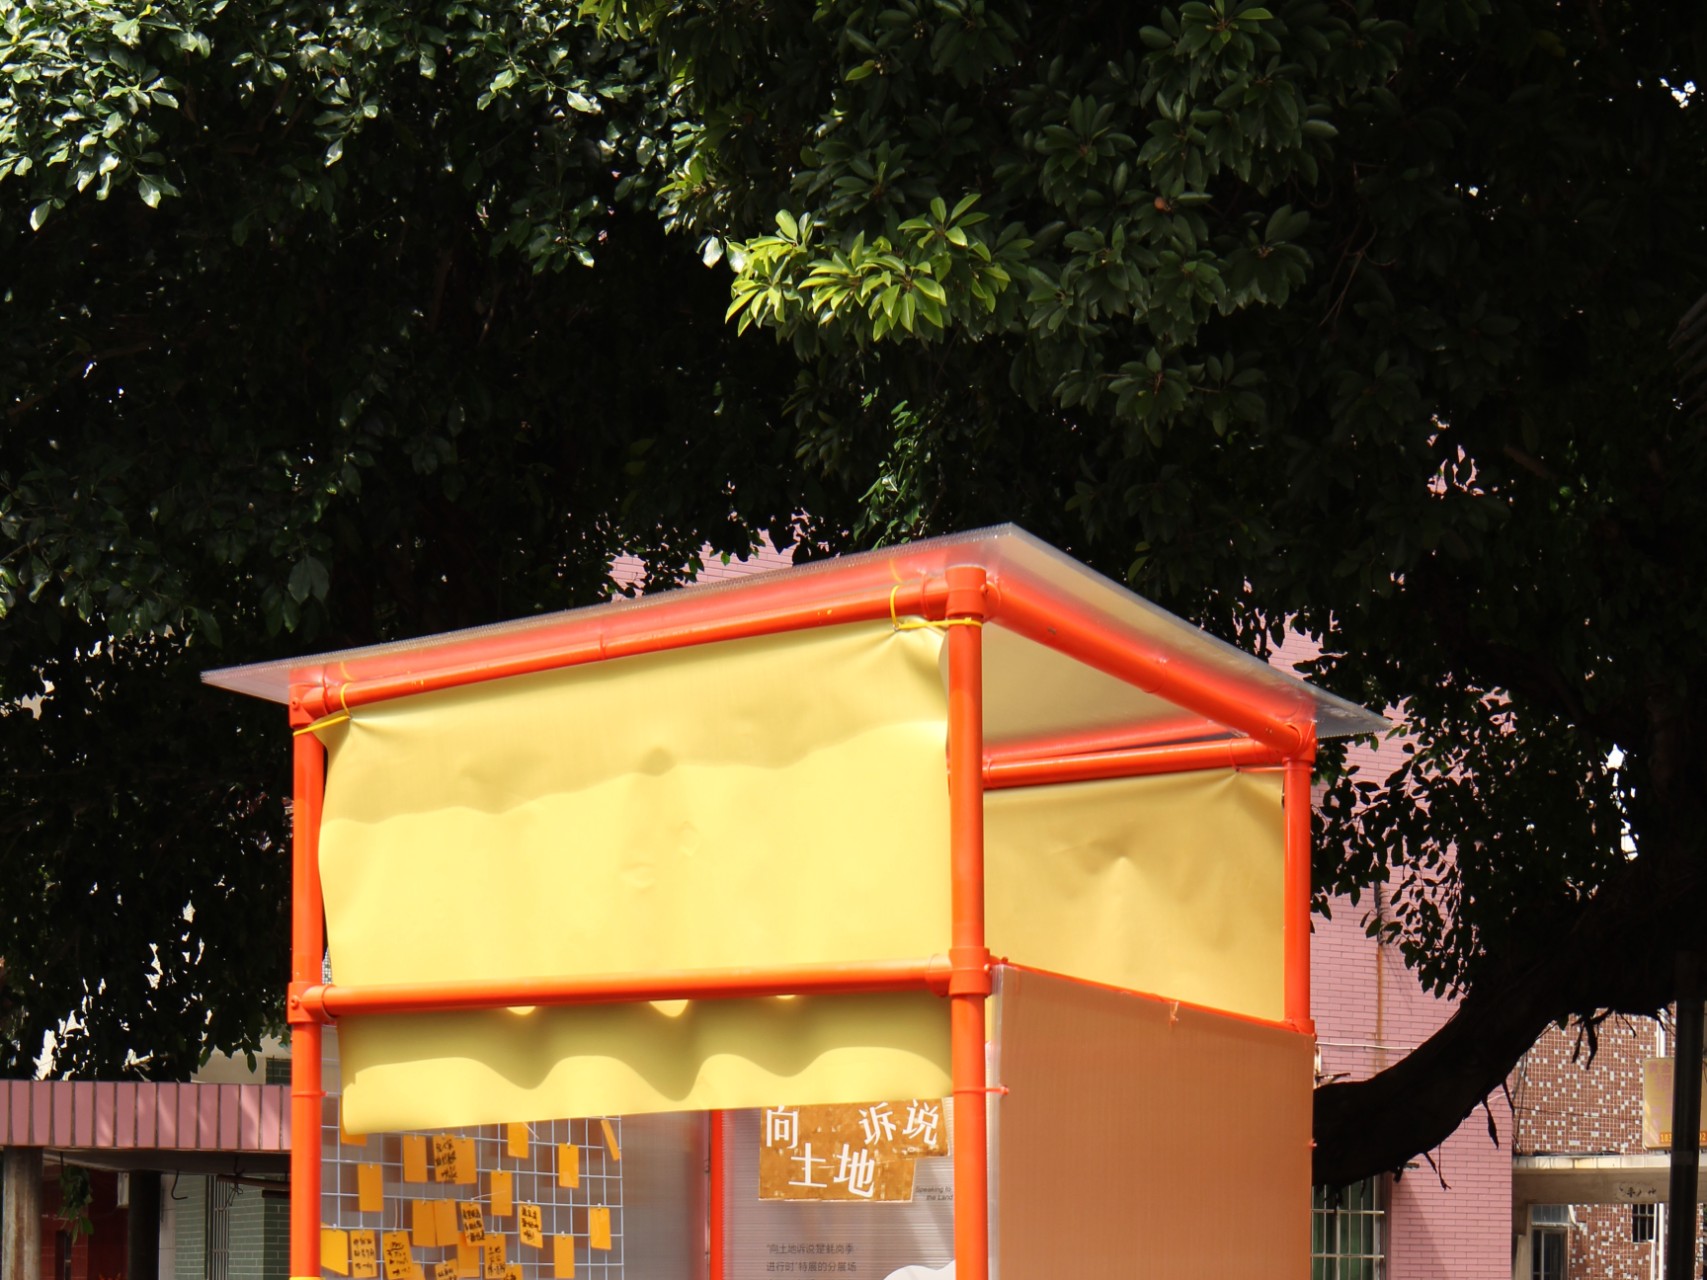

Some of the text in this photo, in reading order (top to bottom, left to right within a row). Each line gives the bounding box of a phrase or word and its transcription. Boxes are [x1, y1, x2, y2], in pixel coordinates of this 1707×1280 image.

[766, 1098, 938, 1149] 向 诉说
[788, 1143, 875, 1197] 土地
